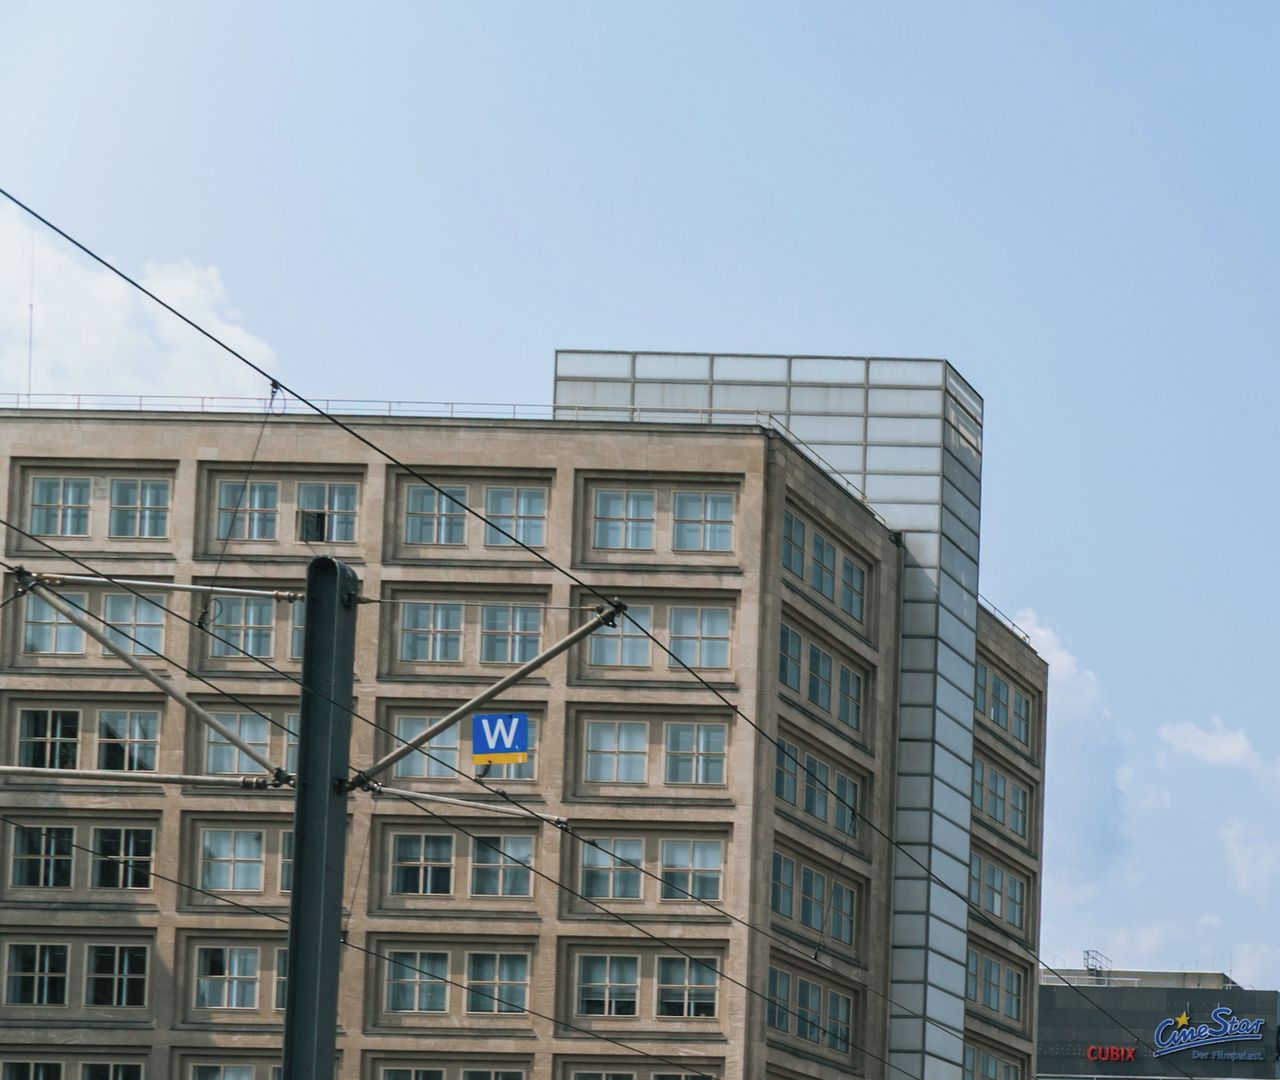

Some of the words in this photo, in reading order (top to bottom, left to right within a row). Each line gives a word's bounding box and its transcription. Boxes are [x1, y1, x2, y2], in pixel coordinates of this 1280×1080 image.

[481, 718, 519, 749] W
[1154, 1007, 1266, 1050] CineStar
[1087, 1045, 1137, 1062] CUBIX
